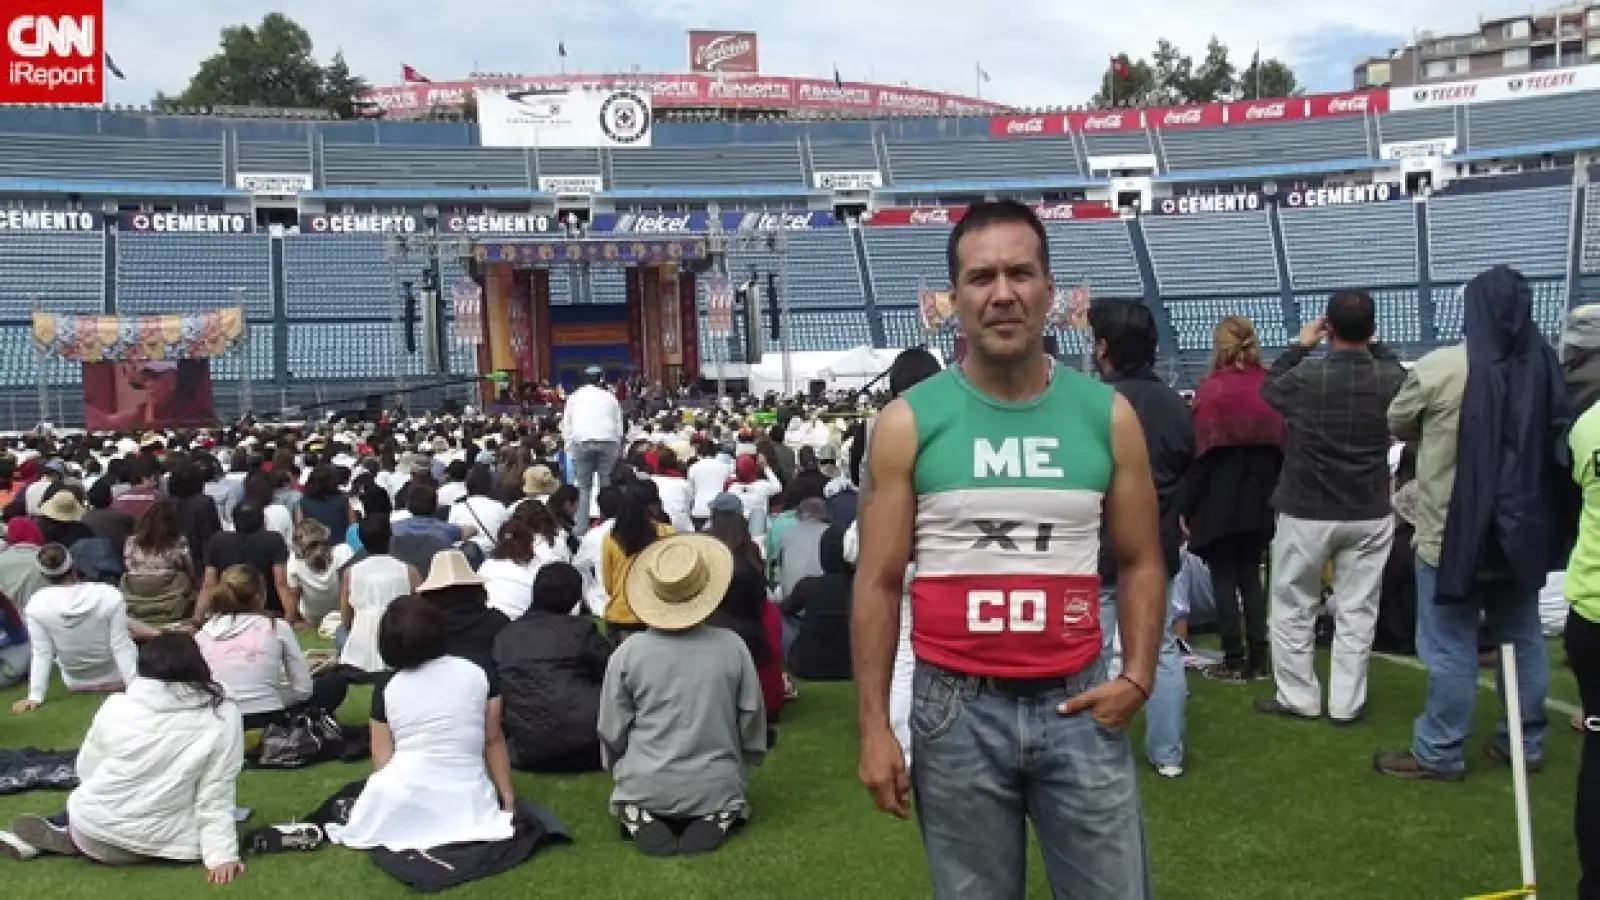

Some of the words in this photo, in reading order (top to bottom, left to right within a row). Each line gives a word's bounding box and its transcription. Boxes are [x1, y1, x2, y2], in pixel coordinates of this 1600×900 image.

[1527, 72, 1577, 90] TECATE
[1431, 83, 1478, 101] TECATE
[1178, 194, 1257, 213] CEMENTO
[1304, 184, 1388, 206] CEMENTO
[153, 214, 244, 231] CEMENTO
[330, 215, 416, 232] CEMENTO
[467, 215, 548, 232] CEMENTO
[973, 436, 1065, 478] ME
[968, 520, 1055, 552] XI
[966, 589, 1047, 632] CO
